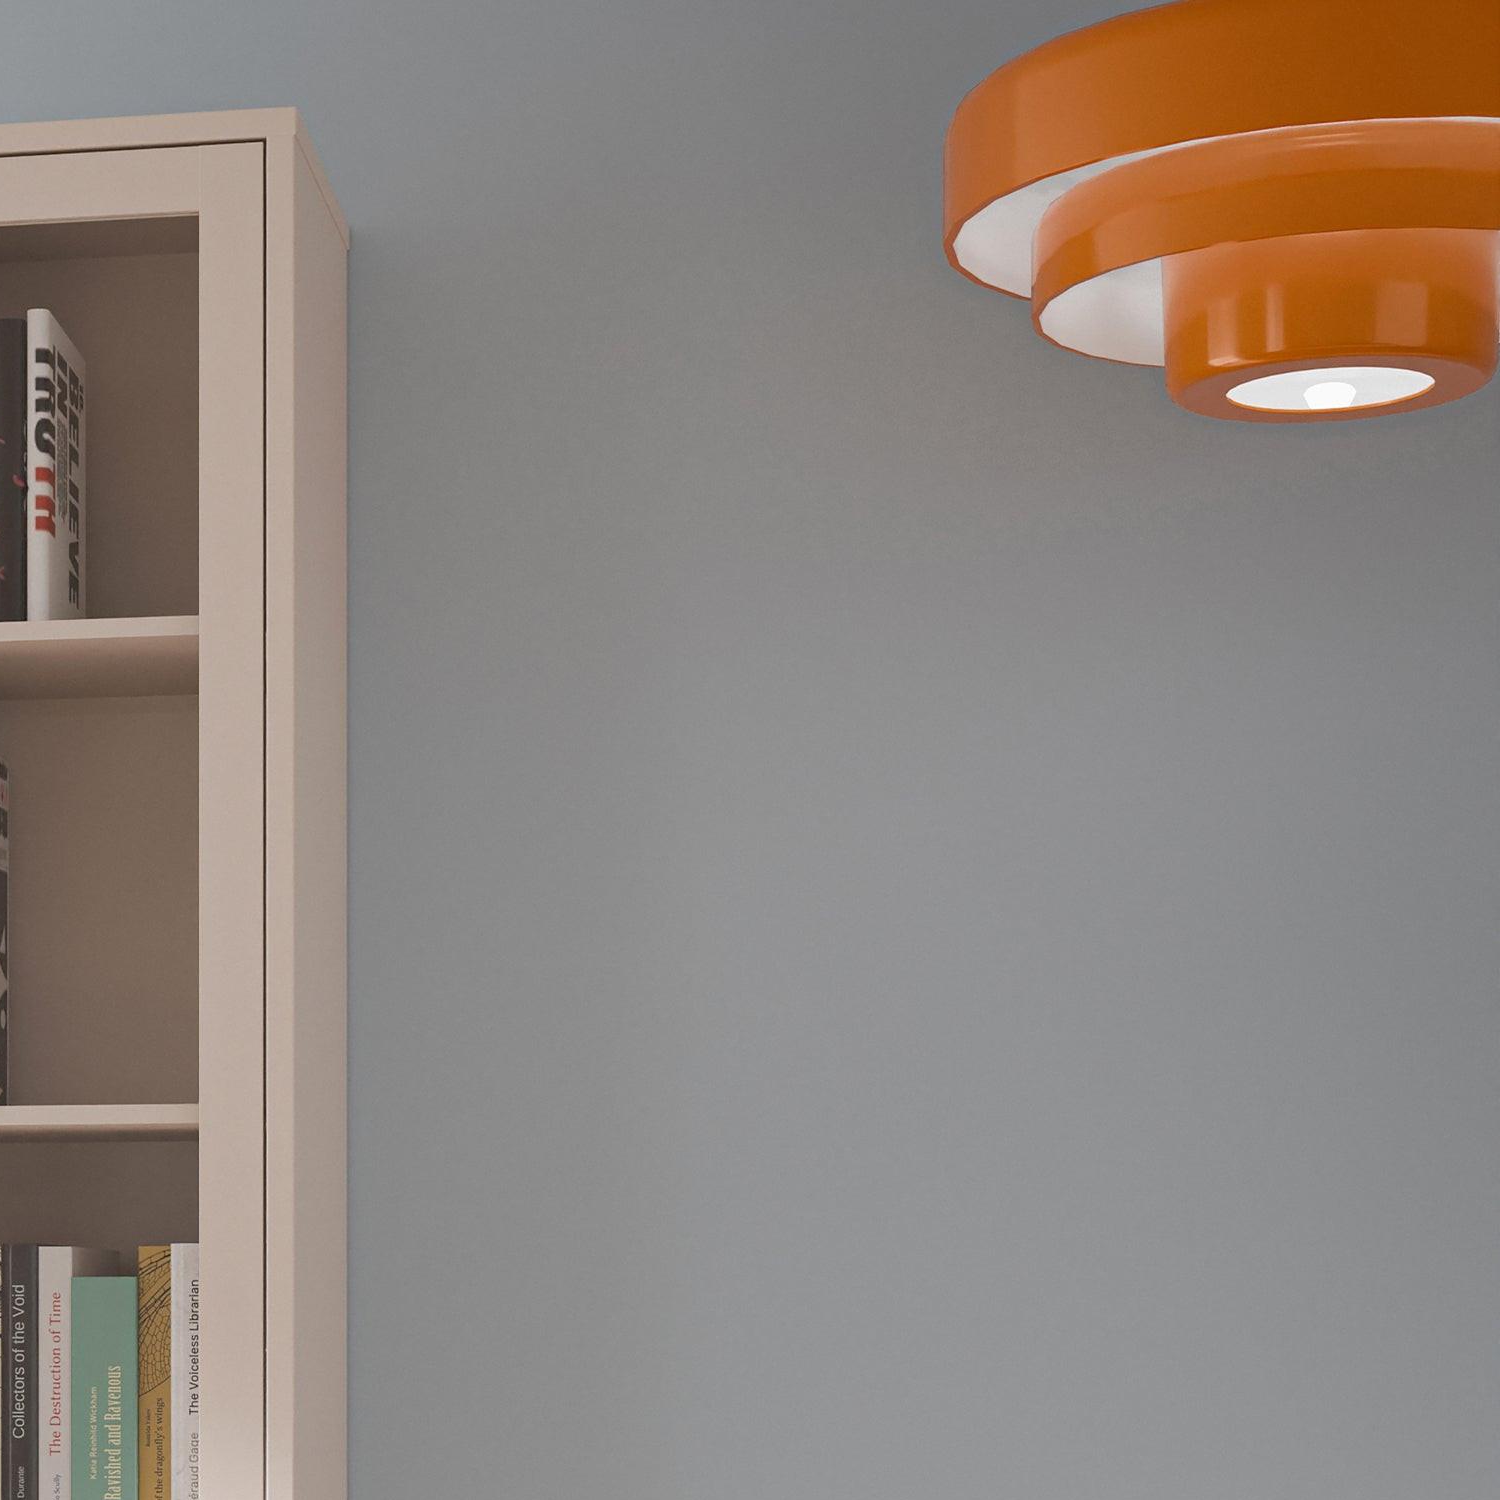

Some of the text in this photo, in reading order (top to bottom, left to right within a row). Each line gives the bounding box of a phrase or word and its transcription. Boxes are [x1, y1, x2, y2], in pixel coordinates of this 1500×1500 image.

[35, 344, 56, 540] TRUTH
[56, 350, 68, 420] IN
[67, 365, 80, 610] BELIEVE
[12, 1285, 24, 1438] Collectors of the Void
[48, 1292, 61, 1456] The Destruction of Time
[155, 1398, 165, 1426] wings
[189, 1280, 199, 1415] The Voiceless Librarian
[104, 1366, 121, 1500] Ravished and Ravenous
[154, 1479, 163, 1494] the
